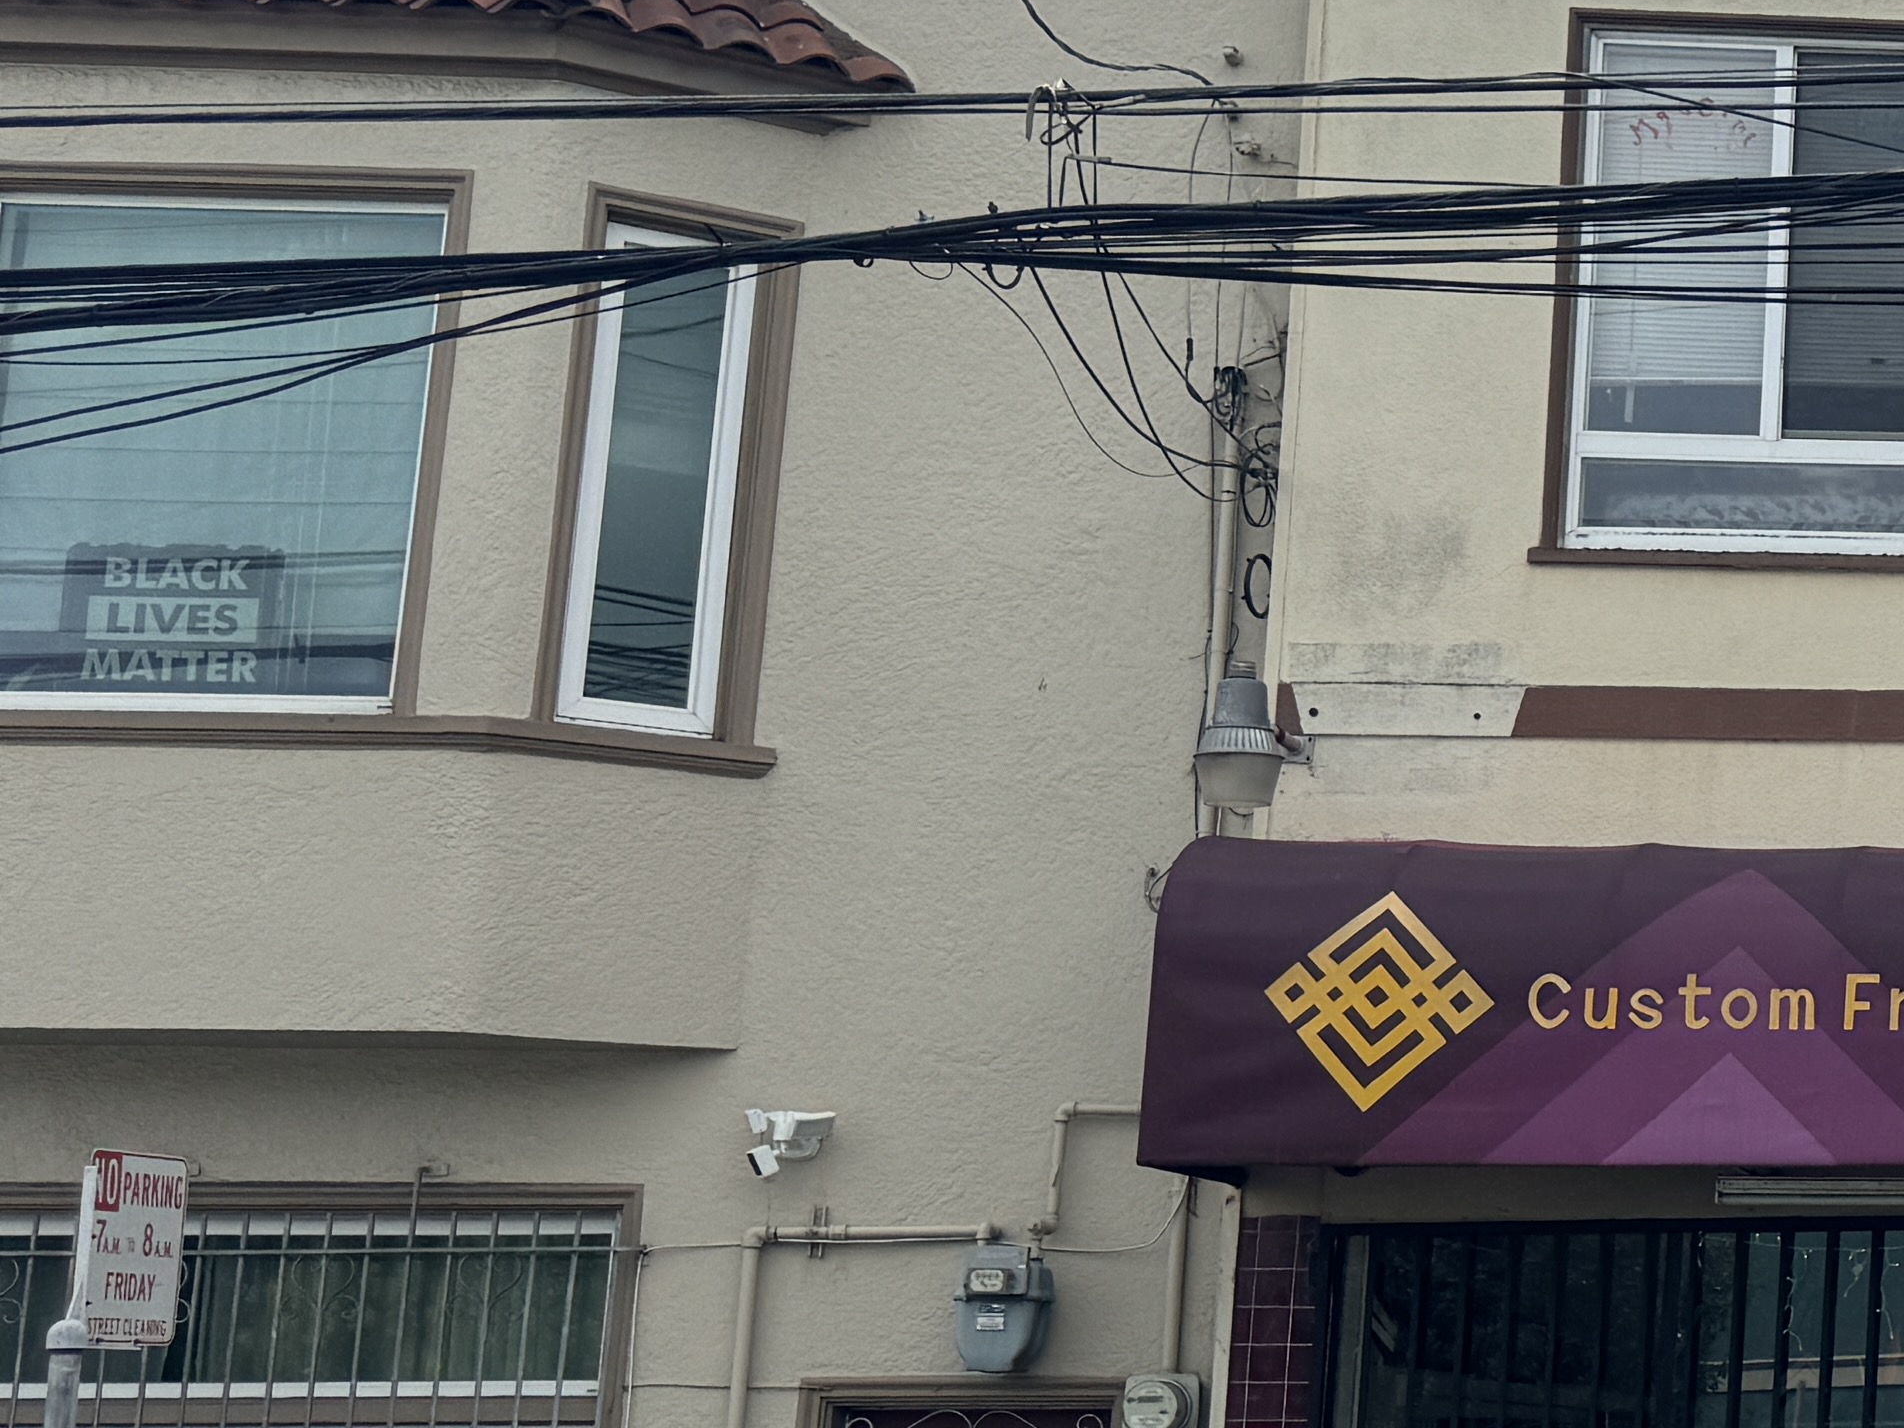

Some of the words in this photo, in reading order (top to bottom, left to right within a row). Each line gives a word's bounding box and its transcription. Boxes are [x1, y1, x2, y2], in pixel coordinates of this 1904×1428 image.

[103, 555, 251, 591] BLACK
[105, 601, 240, 637] LIVES
[79, 647, 258, 683] MATTER
[1530, 975, 1817, 1032] Custom
[122, 1171, 184, 1210] PARKING
[104, 1271, 157, 1302] FRIDAY
[87, 1317, 121, 1336] STREET
[122, 1318, 168, 1337] CLEANING
